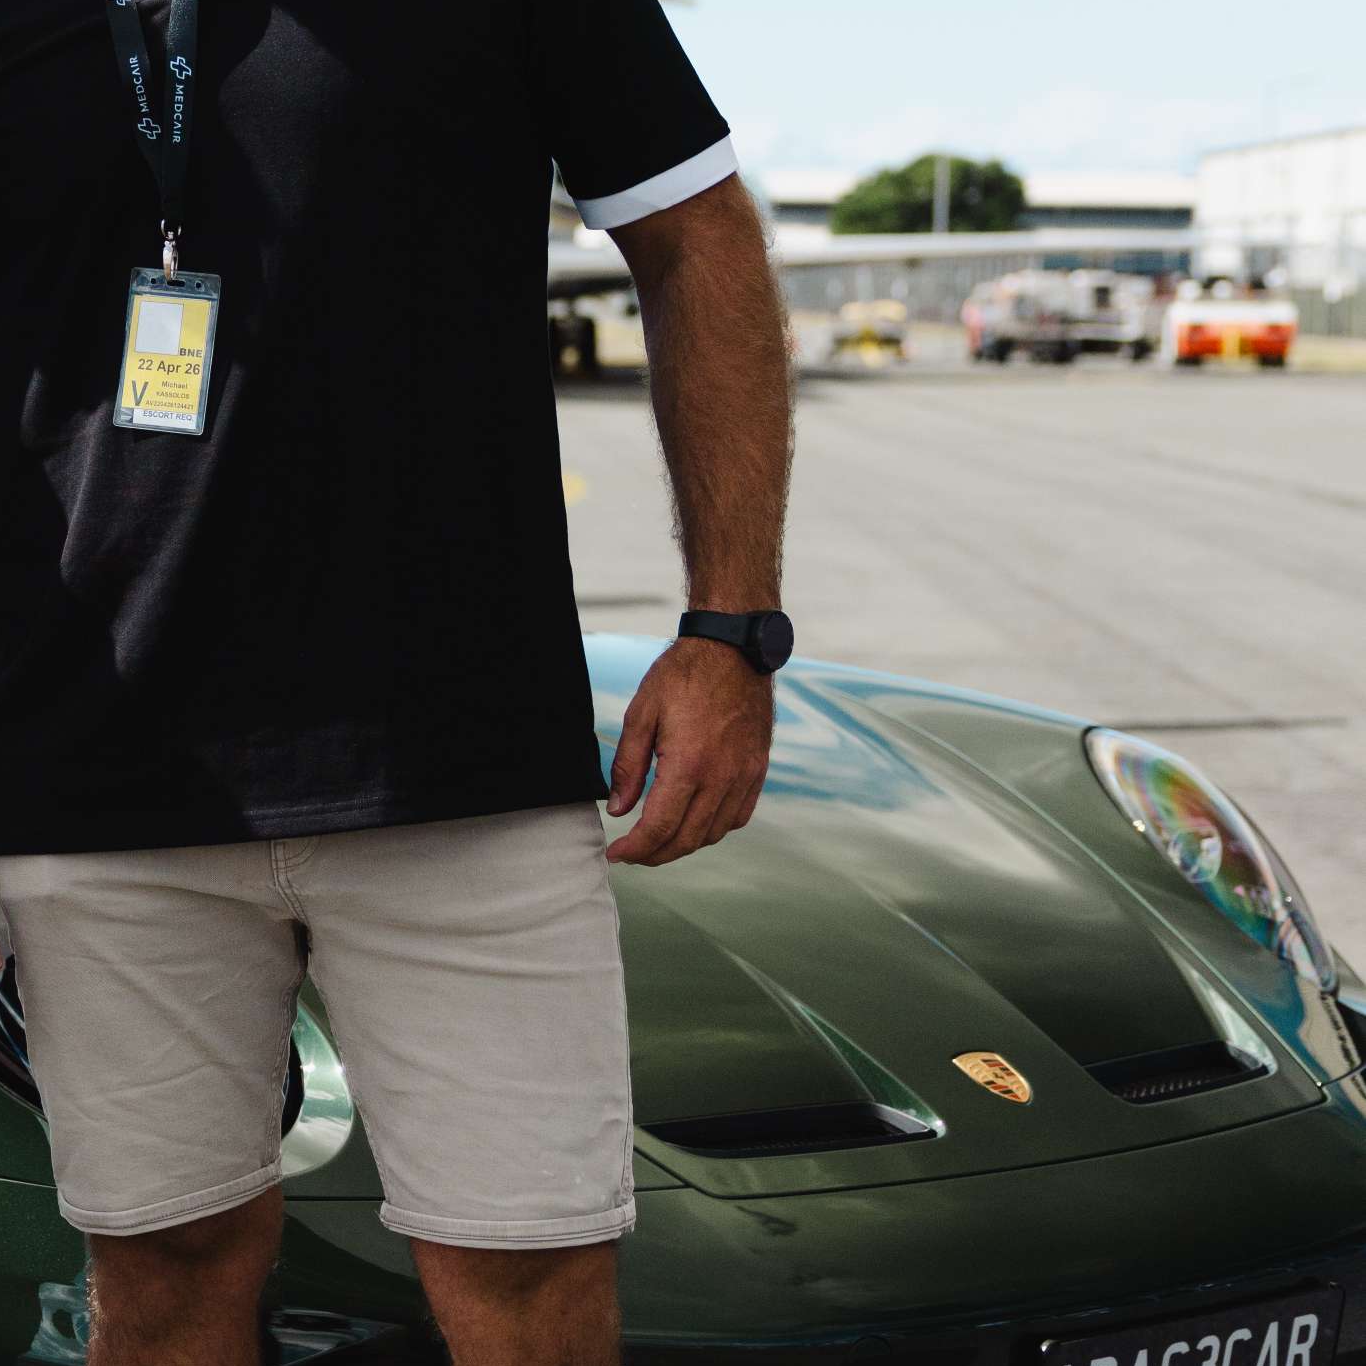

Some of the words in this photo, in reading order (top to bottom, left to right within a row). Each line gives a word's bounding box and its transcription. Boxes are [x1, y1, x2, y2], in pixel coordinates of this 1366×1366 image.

[129, 56, 149, 113] MEDCAIR
[172, 84, 184, 145] MEDCAIR
[179, 348, 203, 358] BNE
[138, 358, 154, 371] 22
[156, 360, 181, 375] Apr
[184, 363, 200, 375] 26
[131, 380, 149, 407] V
[161, 381, 188, 390] Michael
[143, 411, 174, 420] ESCORT
